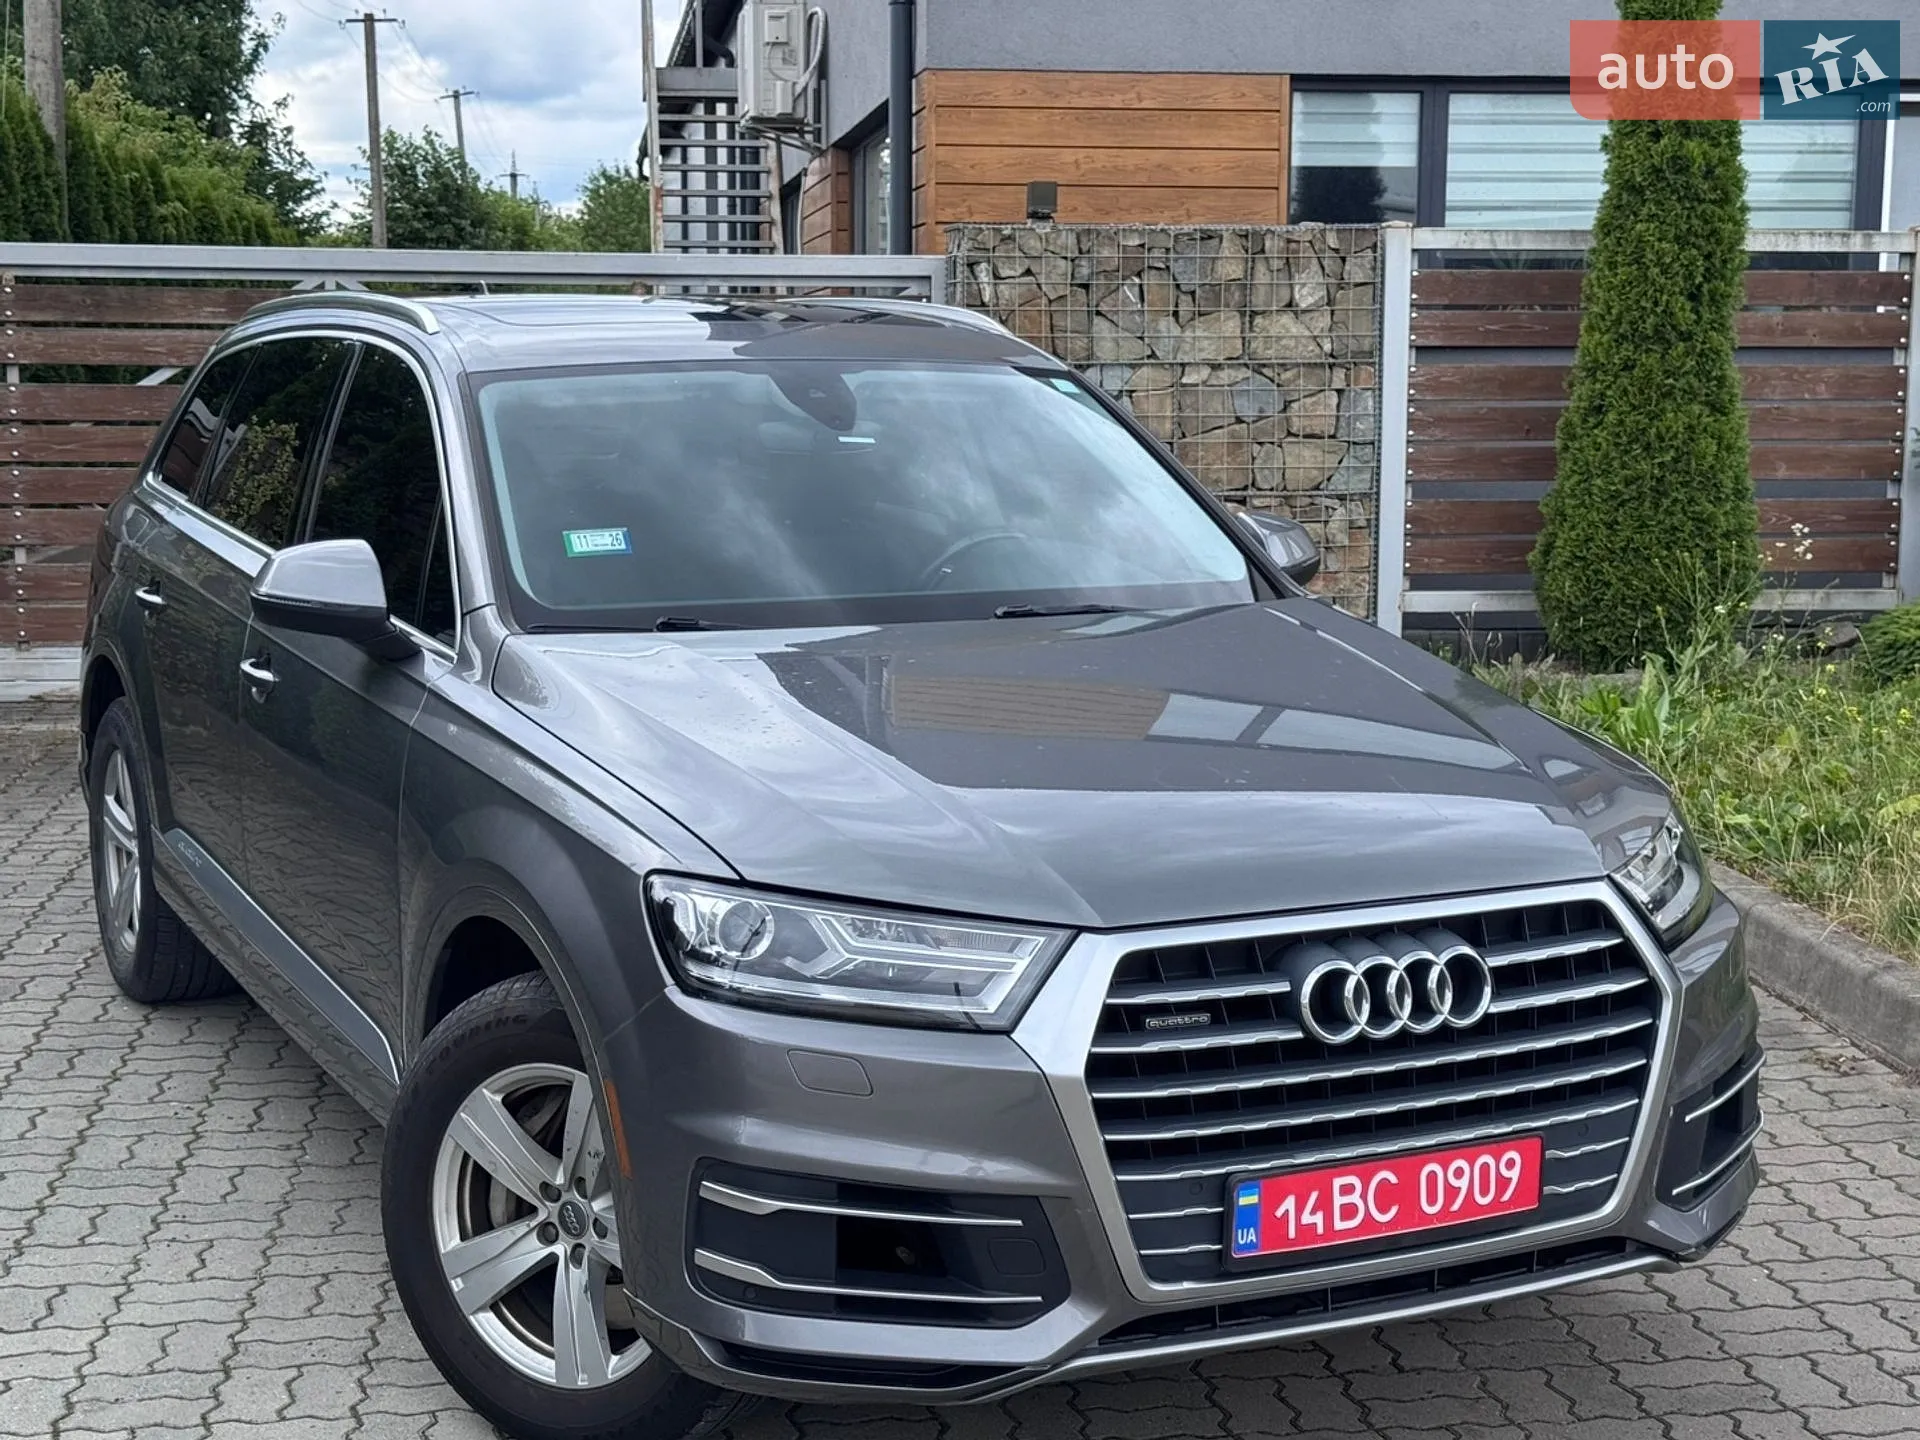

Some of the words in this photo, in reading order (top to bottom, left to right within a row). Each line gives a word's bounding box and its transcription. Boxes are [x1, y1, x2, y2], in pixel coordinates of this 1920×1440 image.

[1148, 1015, 1209, 1028] quattro
[1419, 1150, 1522, 1216] 0909
[1237, 1227, 1257, 1245] UA
